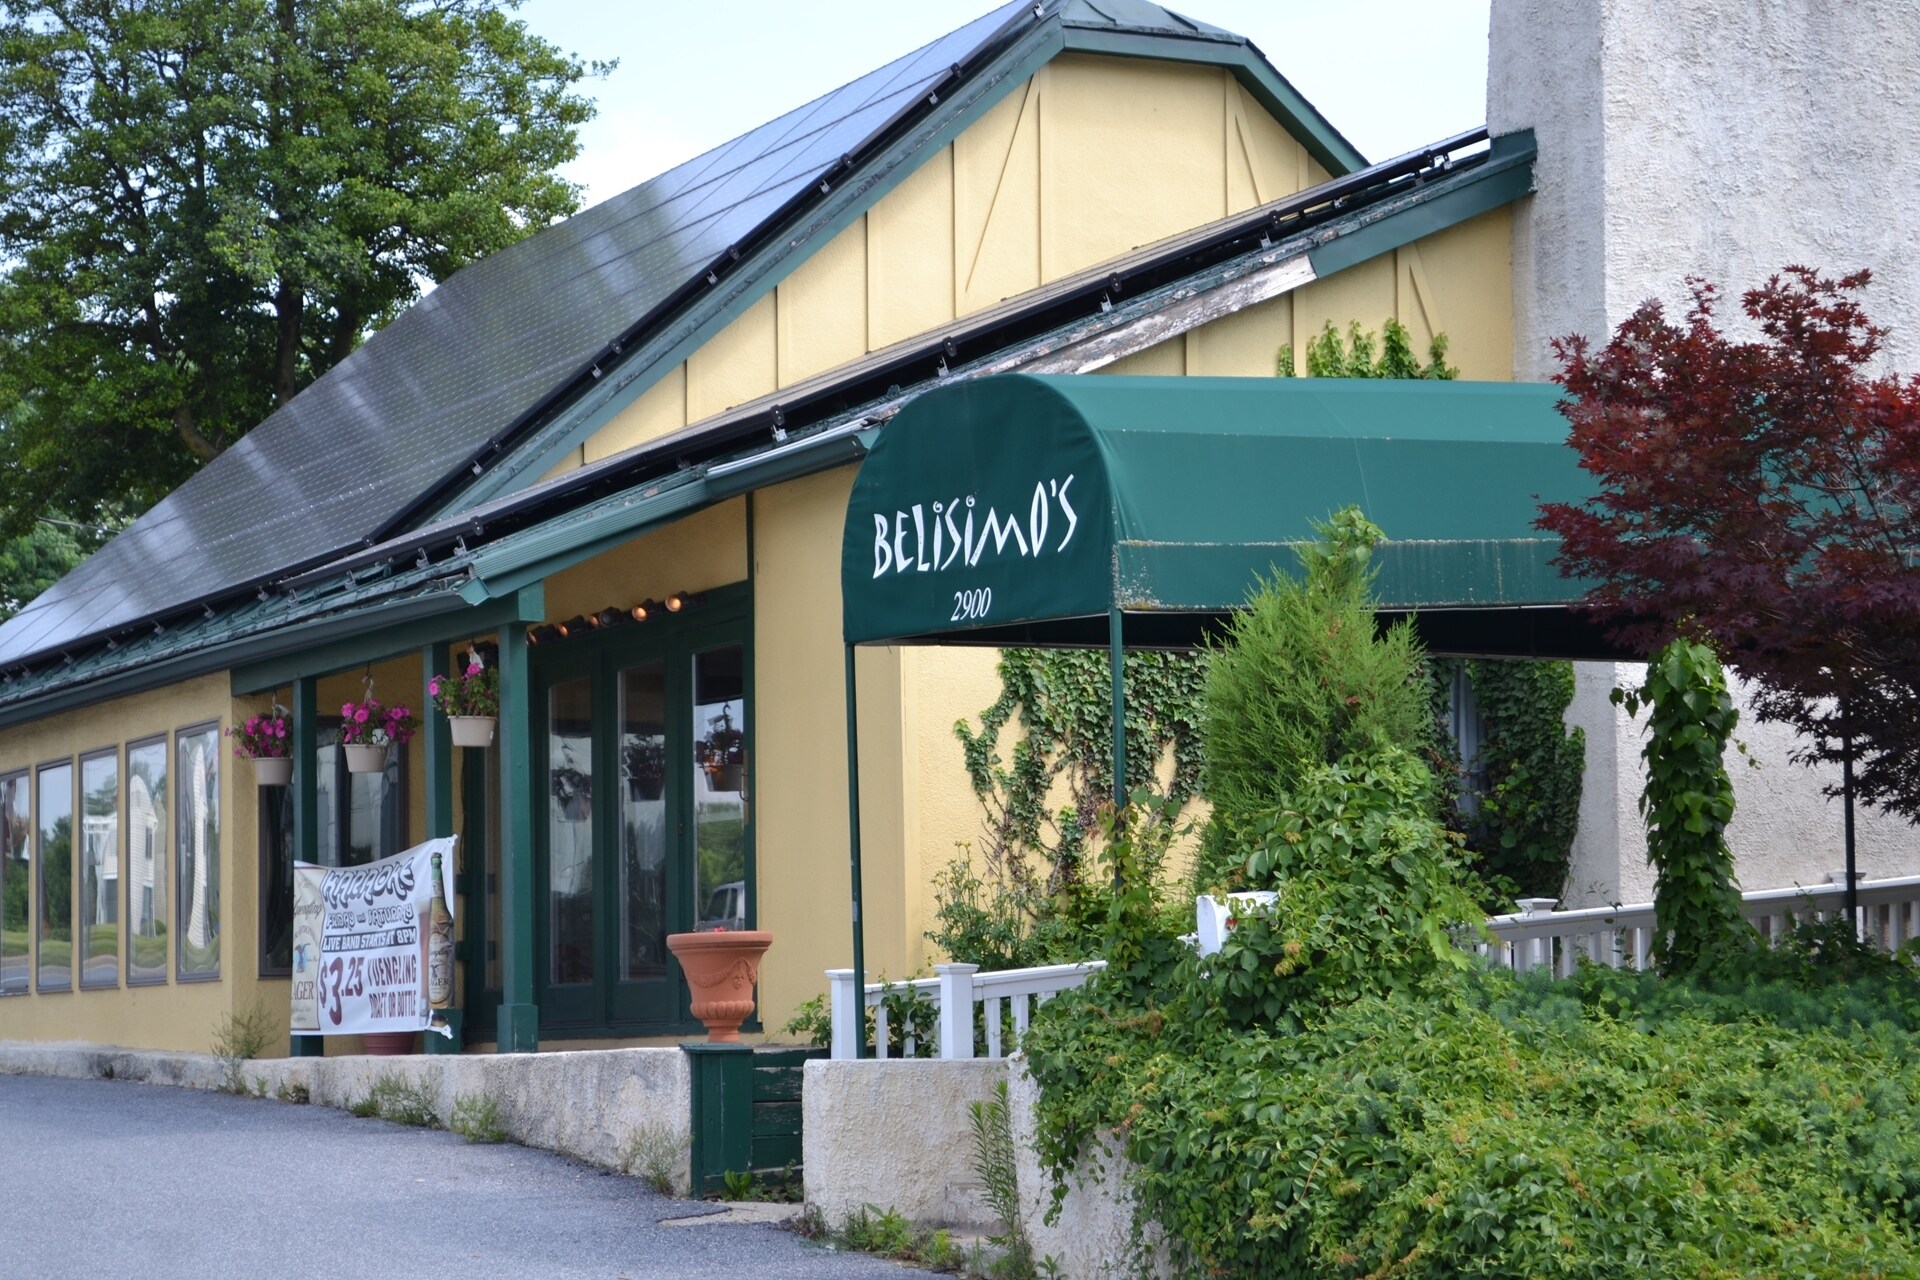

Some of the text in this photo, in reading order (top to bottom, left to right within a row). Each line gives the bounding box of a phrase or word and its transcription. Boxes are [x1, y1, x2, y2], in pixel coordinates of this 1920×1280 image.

[950, 586, 992, 622] 2900
[321, 856, 415, 910] KARAOKE
[326, 911, 355, 931] FRIDAY
[368, 903, 414, 928] SATURDAY
[322, 936, 341, 951] LIVE
[341, 935, 360, 950] BAND
[360, 932, 386, 949] STARTS
[386, 930, 396, 945] AT
[396, 927, 417, 944] 8PM
[367, 954, 416, 987] YUENGLING
[319, 956, 364, 1026] $3.25
[368, 989, 416, 1019] DRAFT OR BOTTLE
